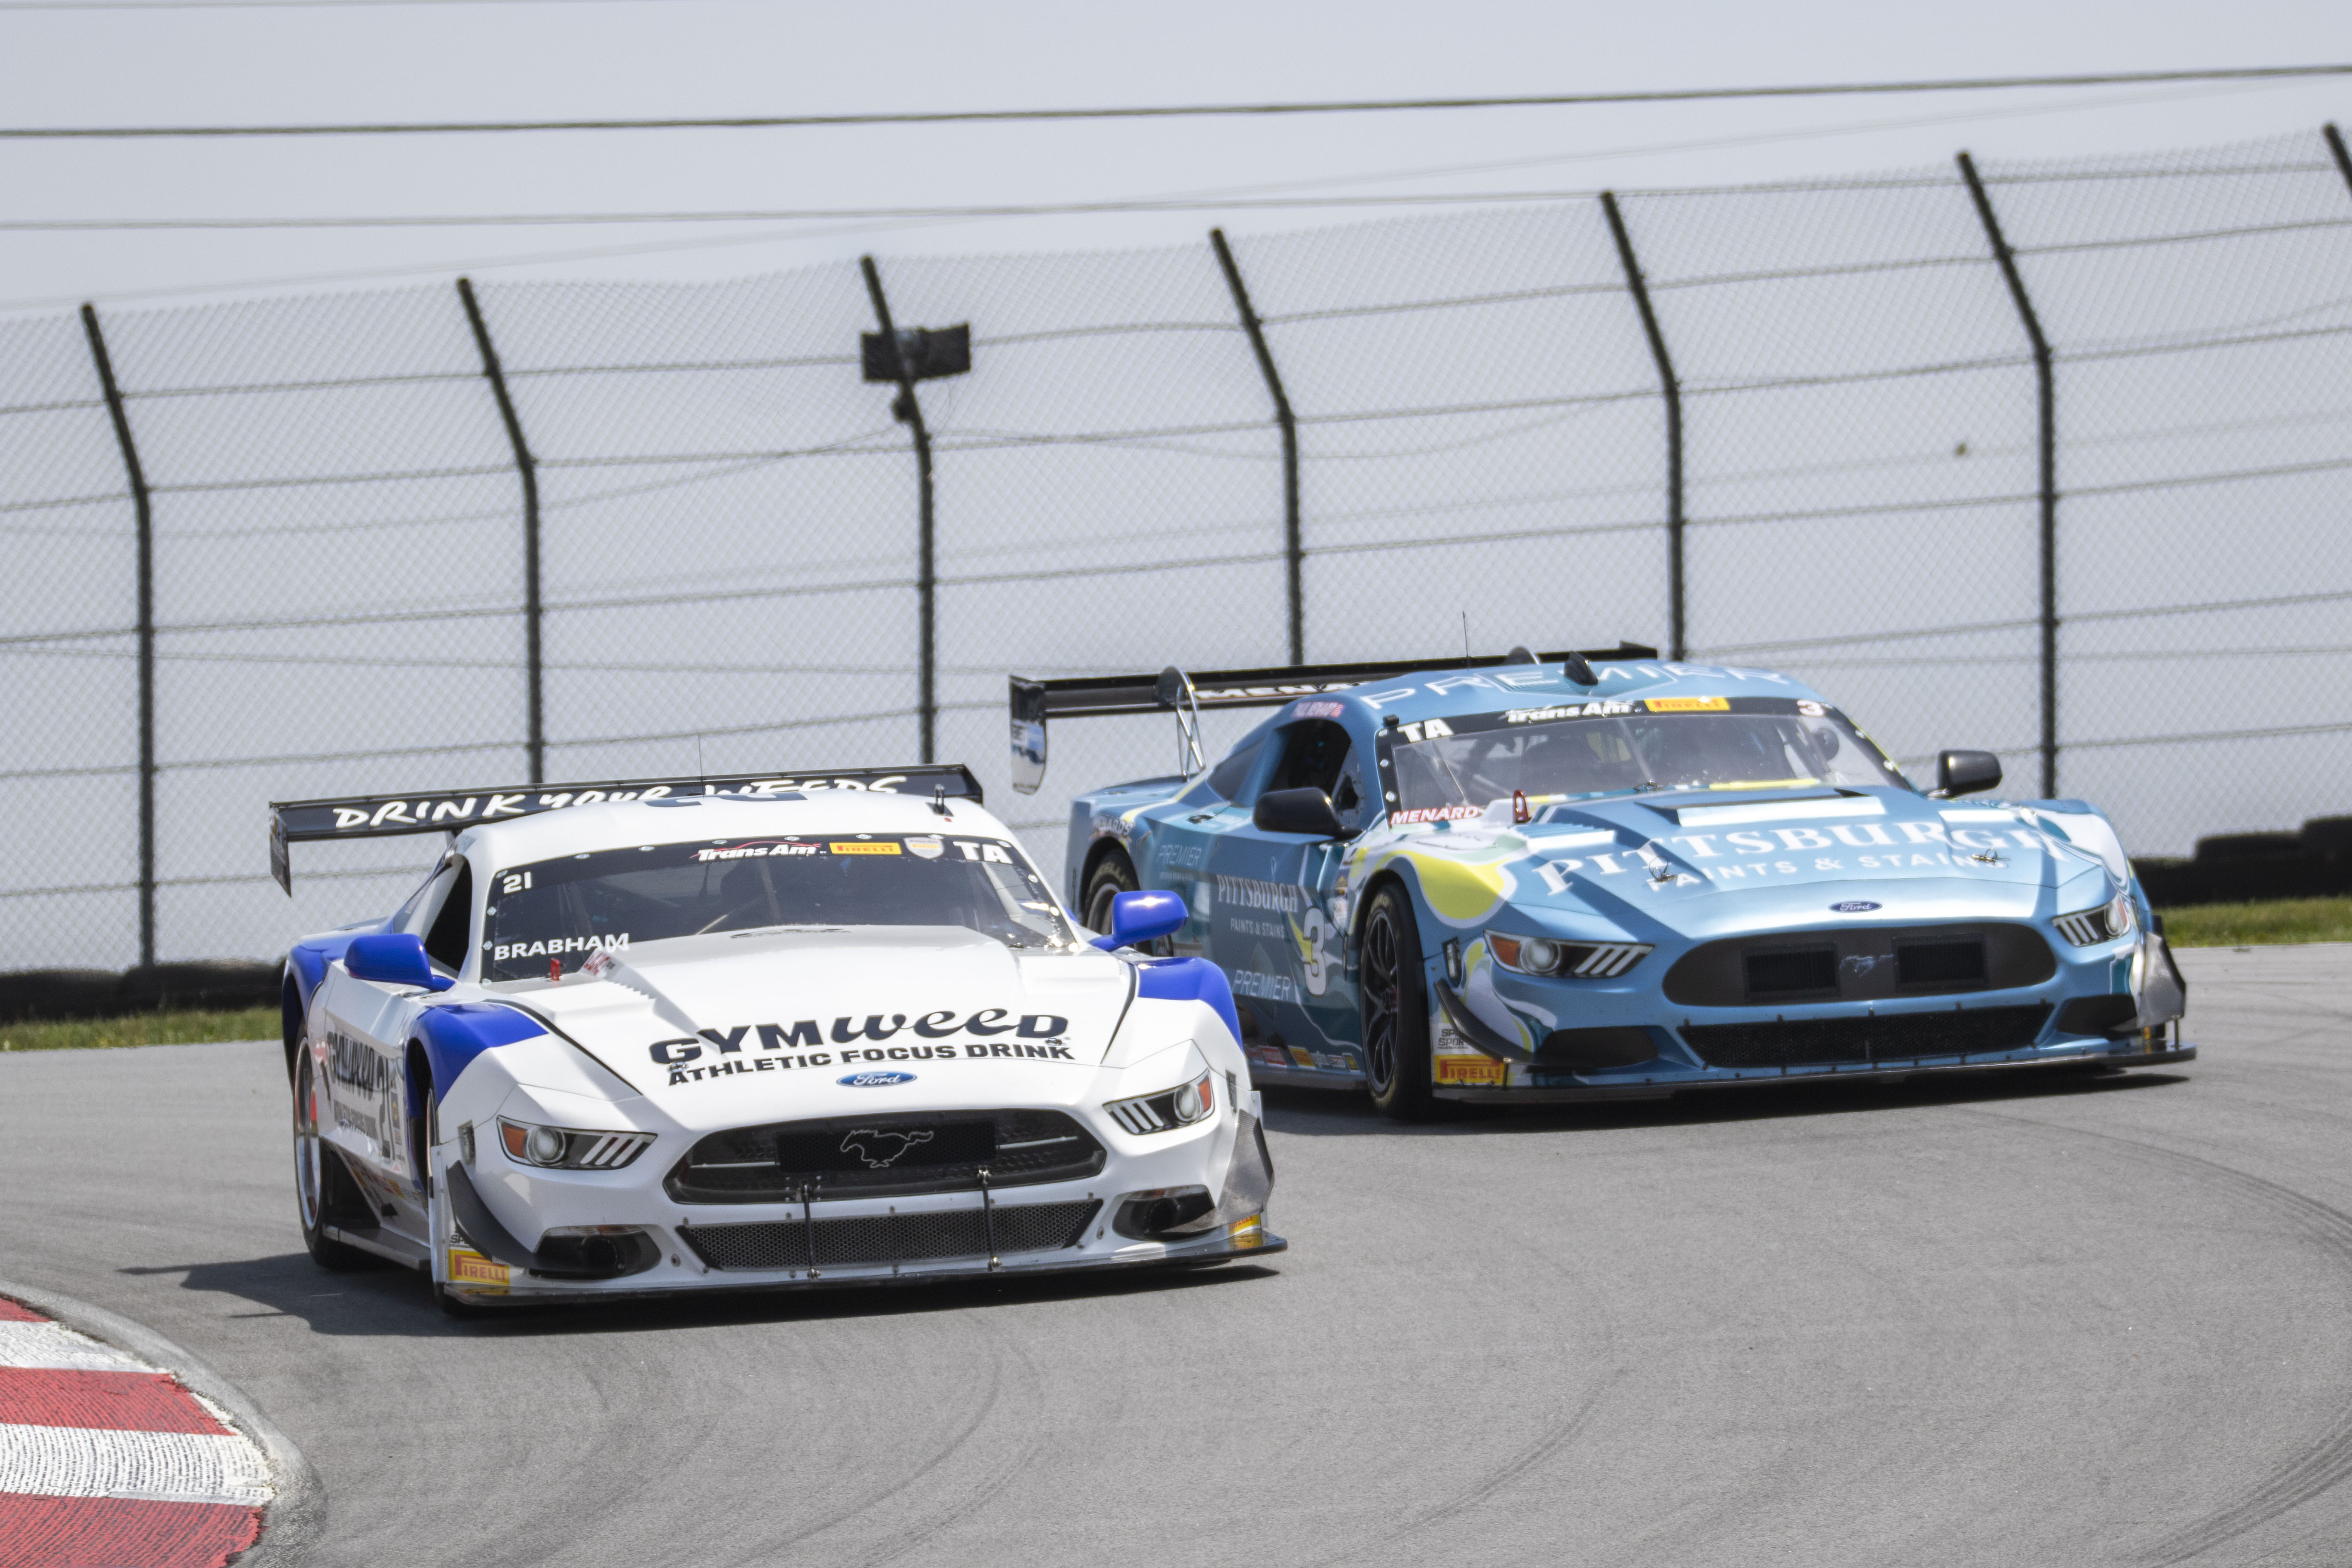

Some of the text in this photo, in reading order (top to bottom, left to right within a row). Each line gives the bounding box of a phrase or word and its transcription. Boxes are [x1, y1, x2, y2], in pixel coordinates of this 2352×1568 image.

[1505, 707, 1580, 723] Trans
[1652, 700, 1720, 709] PIRELLI
[1797, 699, 1824, 716] 3
[1397, 718, 1455, 743] TA
[333, 793, 527, 828] DRINK
[1390, 806, 1479, 824] MENARD
[698, 848, 769, 862] Trans
[769, 844, 817, 855] Am
[952, 841, 1013, 864] TA
[1533, 822, 2070, 895] PITTSBURGH
[503, 871, 532, 894] 21
[1646, 861, 1798, 893] PAINTS
[1814, 858, 1844, 870] &
[1216, 874, 1298, 913] PITTSBURGH
[1231, 918, 1253, 935] PAINTS
[1262, 922, 1285, 939] STAINS
[493, 933, 630, 961] BRABHAM
[1303, 906, 1326, 997] 3
[1231, 969, 1291, 1001] PREMIER
[669, 1043, 1076, 1087] ATHLETIC FOCUS DRINK
[1440, 1059, 1500, 1079] PIRELLI
[455, 1254, 505, 1281] PIRELLI
